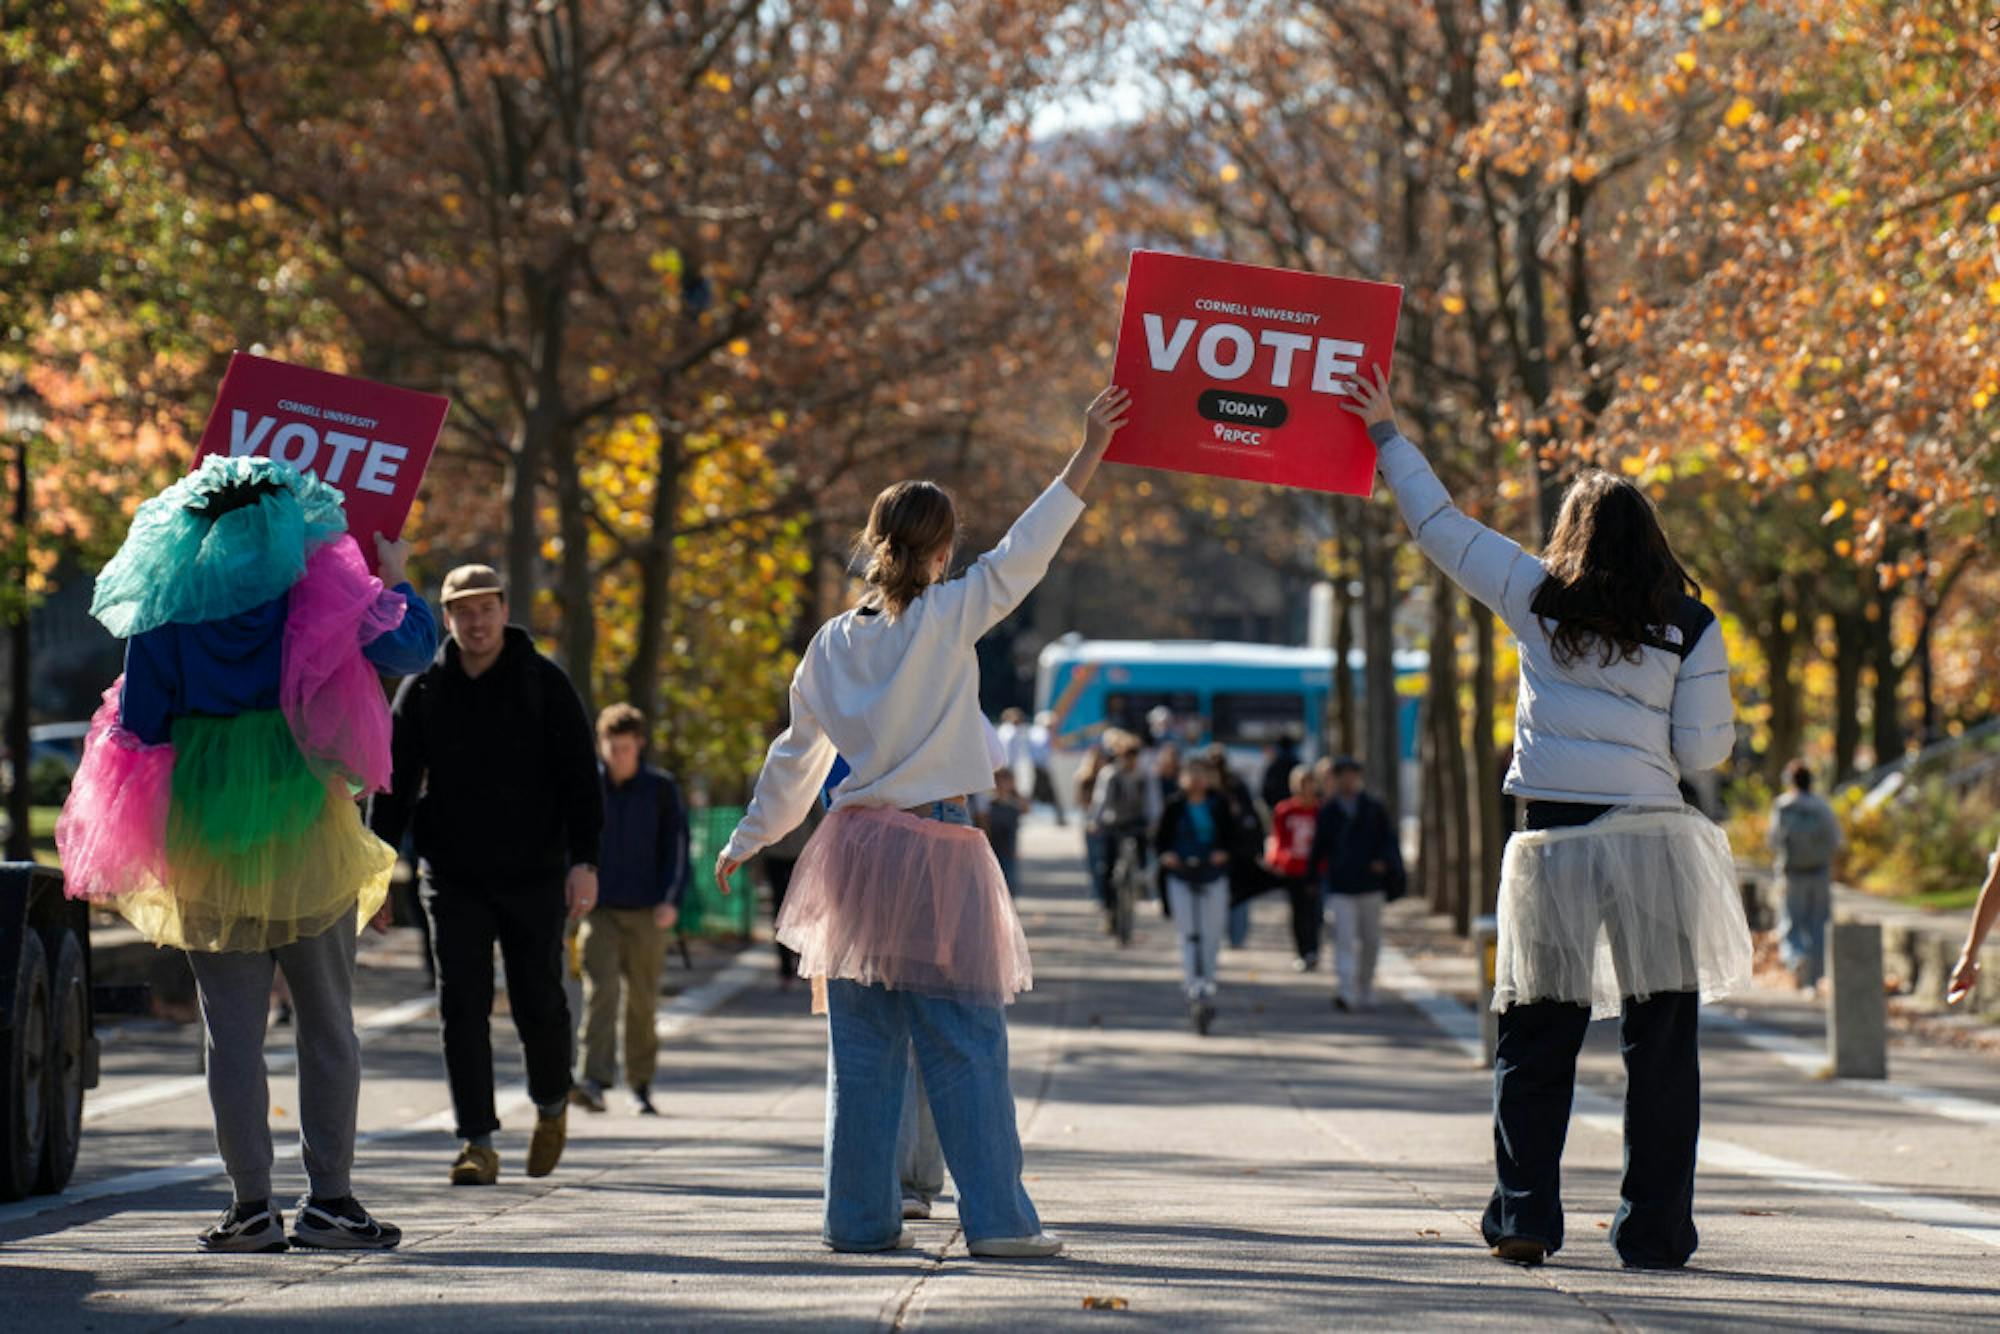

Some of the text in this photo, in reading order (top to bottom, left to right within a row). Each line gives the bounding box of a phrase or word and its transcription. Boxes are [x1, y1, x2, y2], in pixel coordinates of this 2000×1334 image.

[1195, 299, 1321, 325] CORNELL UNIVERSITY
[1143, 313, 1365, 395] VOTE
[277, 399, 378, 428] CORNELL UNIVERSITY
[1217, 399, 1268, 418] TODAY
[1223, 429, 1262, 445] RPCC
[230, 409, 409, 495] VOTE
